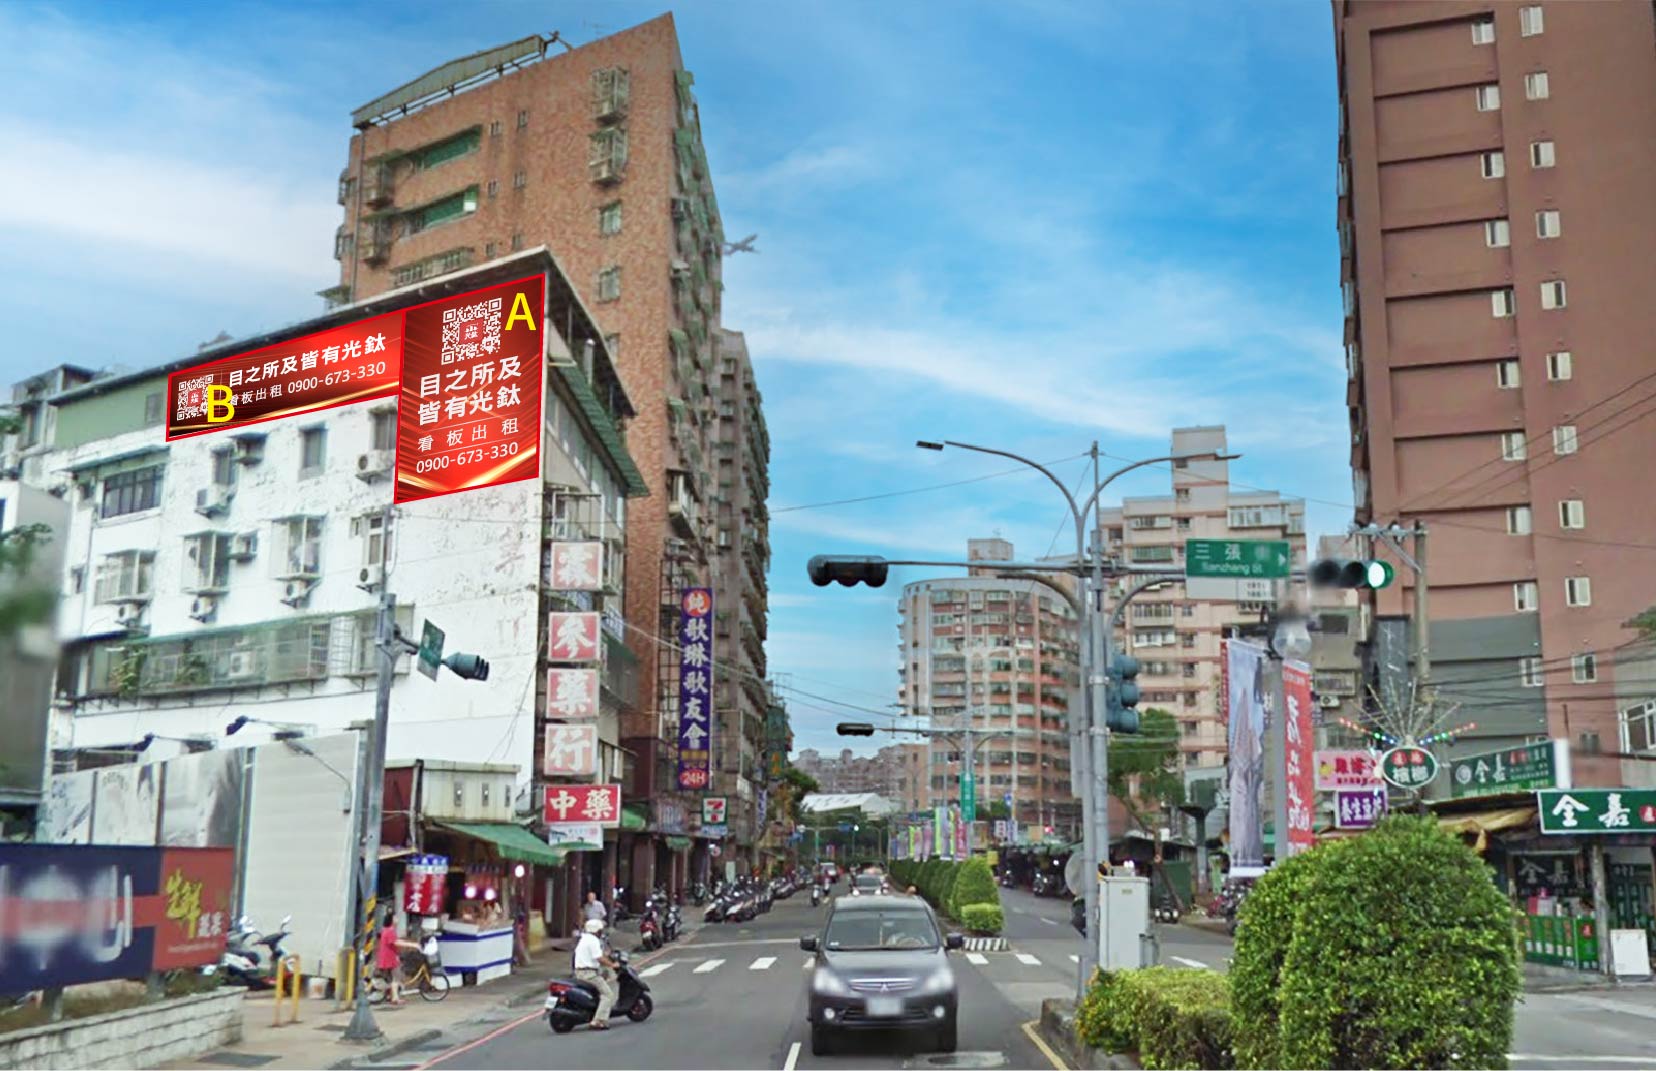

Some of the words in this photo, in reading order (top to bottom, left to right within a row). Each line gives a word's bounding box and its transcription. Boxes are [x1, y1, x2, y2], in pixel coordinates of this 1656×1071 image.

[229, 333, 386, 387] 目之所及皆有光鈦
[288, 361, 386, 394] 0900-673-330
[420, 356, 521, 398] 目之所及
[418, 384, 521, 425] 皆有光鈦
[416, 442, 519, 473] 0900-673-330
[549, 788, 614, 820] 中藥
[1552, 793, 1630, 828] 全嘉
